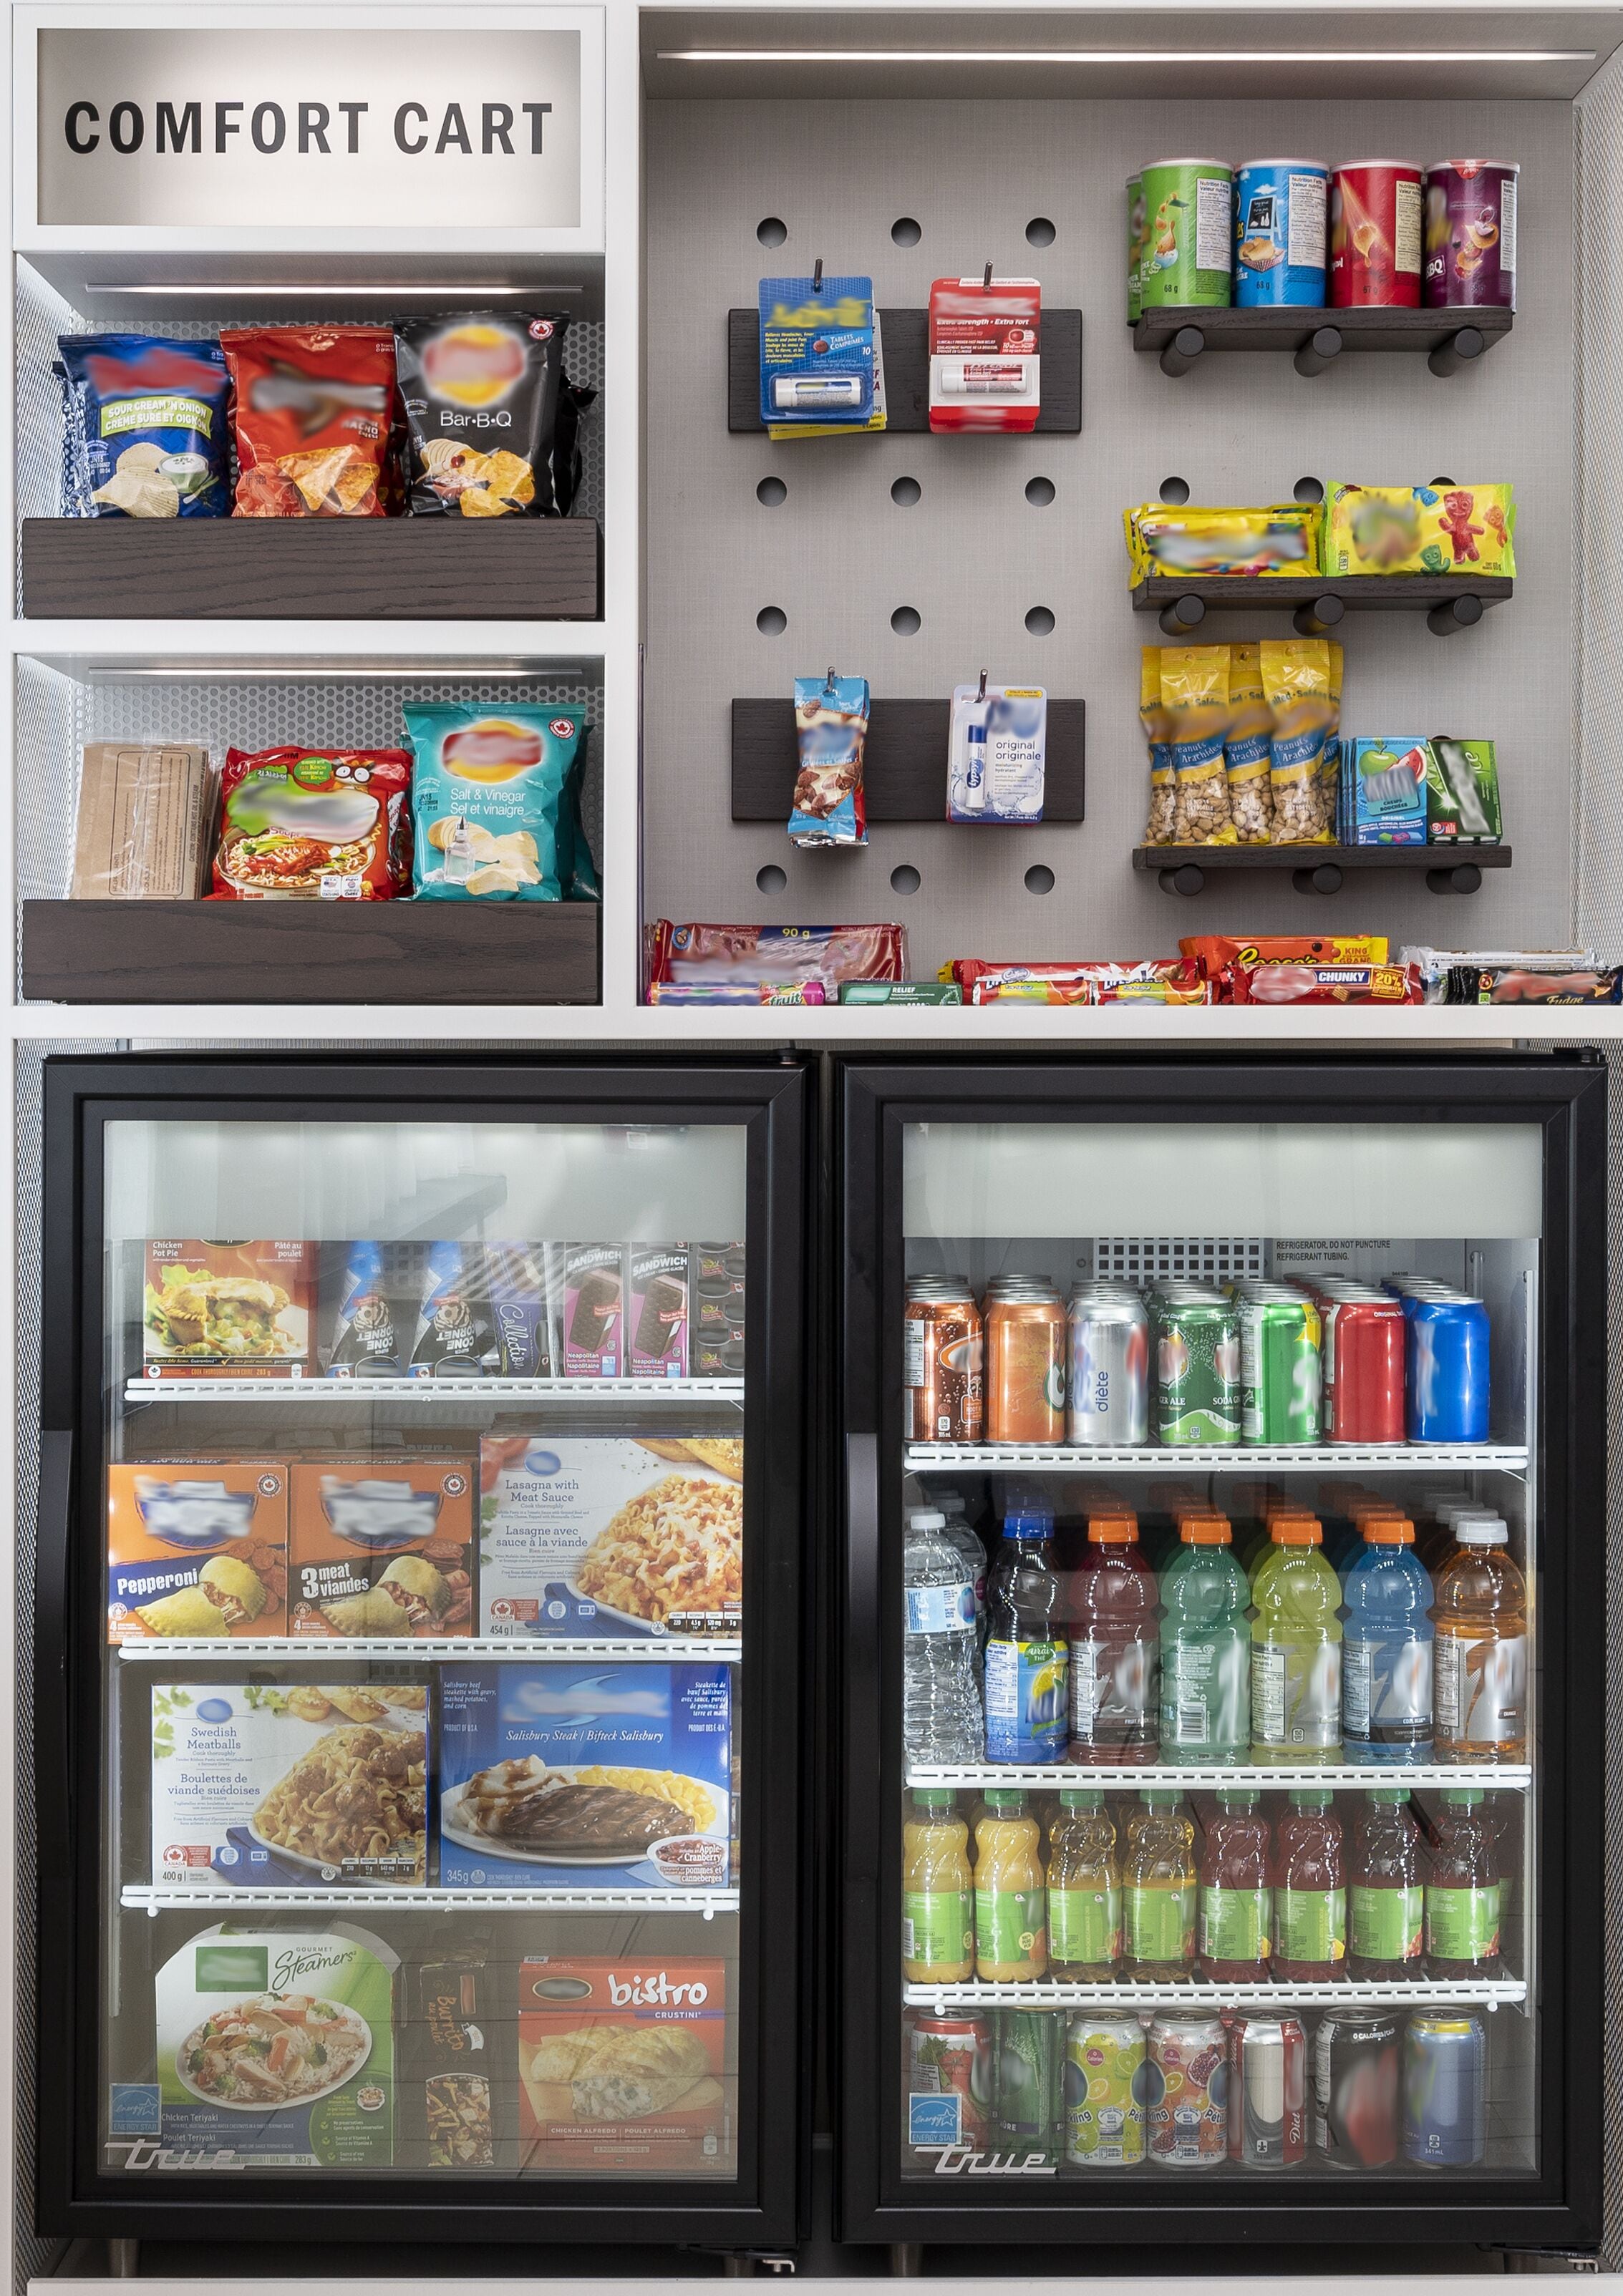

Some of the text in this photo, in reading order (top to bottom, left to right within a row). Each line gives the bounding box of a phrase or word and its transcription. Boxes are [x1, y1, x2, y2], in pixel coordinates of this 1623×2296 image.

[64, 101, 553, 155] COMFORT CART
[1256, 281, 1264, 289] 68
[109, 404, 132, 419] SOUR
[134, 400, 166, 411] CREAM
[180, 401, 207, 418] ONION
[105, 412, 207, 432] CRÈME SURE ET OIGNON
[997, 741, 1035, 751] original
[1274, 738, 1308, 751] Peanuts
[996, 751, 1041, 762] originale
[1182, 744, 1221, 763] Arachides
[450, 787, 525, 805] Salt & Vinegar
[450, 802, 524, 817] Sel et vinaigre
[783, 928, 810, 940] 90 g
[1319, 972, 1365, 983] CHUNKY
[1375, 973, 1401, 987] 20%
[770, 990, 801, 1005] fruit
[1546, 995, 1584, 1005] Fudge
[274, 1241, 291, 1250] Pâté
[1329, 1240, 1338, 1249] DO
[1340, 1240, 1355, 1249] NOT
[1356, 1240, 1390, 1249] PUNCTURE
[278, 1250, 302, 1258] poulet
[1276, 1252, 1350, 1261] REFRIGERANT TUBING.
[567, 1251, 621, 1272] SANDWICH
[633, 1257, 688, 1277] SANDWICH
[499, 1303, 528, 1371] Collection
[367, 1336, 393, 1351] CONE
[446, 1336, 474, 1351] CONE
[1095, 1371, 1108, 1412] diète
[1171, 1397, 1186, 1406] ALE
[1213, 1396, 1232, 1405] SODA
[505, 1479, 579, 1492] Lasagna with
[510, 1492, 573, 1502] Meat Sauce
[506, 1525, 551, 1537] Lasagne
[530, 1537, 536, 1547] à
[539, 1537, 548, 1547] la
[551, 1537, 588, 1547] viande
[319, 1562, 351, 1581] meat
[117, 1568, 198, 1596] Pepperoni
[301, 1567, 319, 1599] 3
[321, 1577, 370, 1597] viandes
[110, 1620, 117, 1632] 4
[294, 1619, 301, 1630] 4
[490, 1625, 509, 1638] 454 g
[191, 1726, 237, 1738] Swedish
[444, 1723, 467, 1732] PRODUCT OF
[688, 1723, 705, 1732] PRODUIT
[506, 1729, 550, 1743] Salisbury
[552, 1729, 578, 1741] Steak
[586, 1729, 618, 1743] Bifteck
[619, 1729, 664, 1743] Salisbury
[187, 1739, 241, 1750] Meatballs
[180, 1773, 248, 1783] Boulettes de
[168, 1784, 260, 1795] viande suédoises
[699, 1844, 722, 1854] Apple-
[684, 1853, 722, 1862] Cranberry
[685, 1865, 722, 1875] pommes et
[163, 1871, 182, 1883] 400 g
[681, 1874, 722, 1884] canneberges
[272, 1948, 353, 1991] Steamers
[607, 1972, 708, 2006] bistro
[437, 1995, 465, 2050] Burrito
[425, 2016, 445, 2046] poulet
[161, 2113, 218, 2124] Chicken Teriyaki
[914, 2113, 943, 2127] energy
[113, 2123, 136, 2131] ENERGY
[1289, 2112, 1301, 2144] Diet
[163, 2134, 215, 2143] Poulet Teriyaki
[912, 2133, 956, 2142] ENERGY STAR
[105, 2138, 246, 2170] true
[914, 2144, 1057, 2174] true
